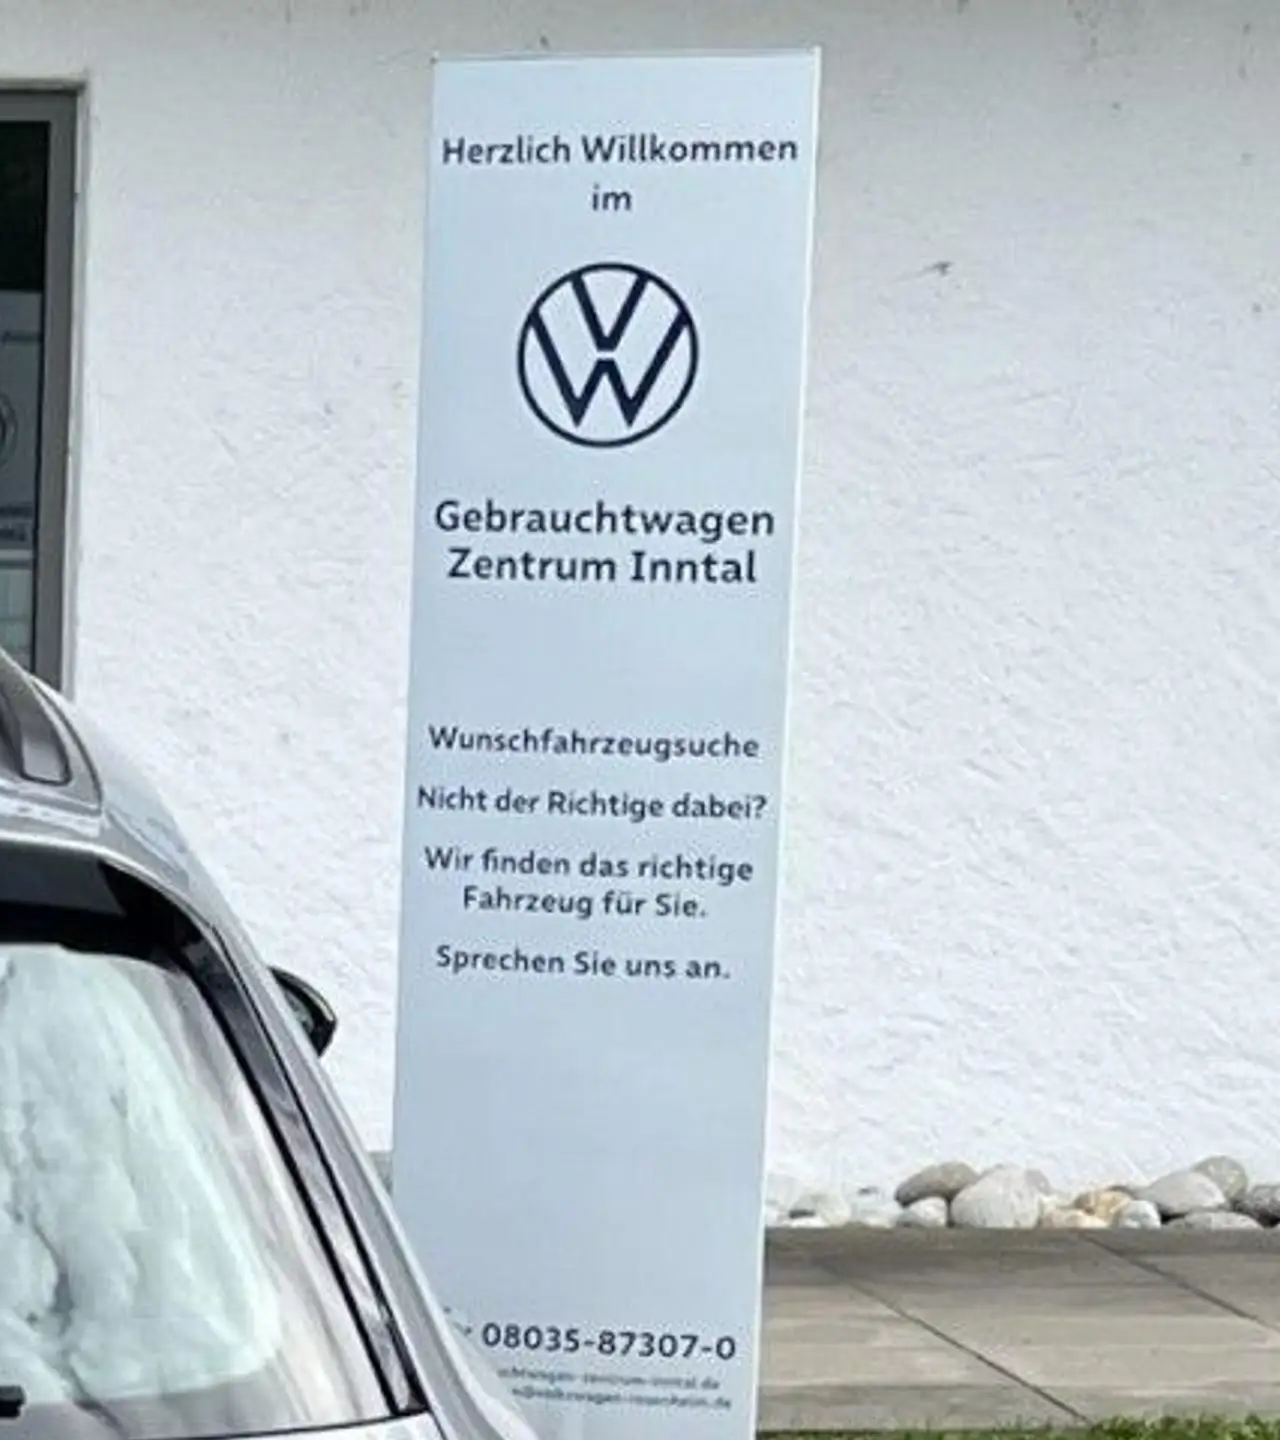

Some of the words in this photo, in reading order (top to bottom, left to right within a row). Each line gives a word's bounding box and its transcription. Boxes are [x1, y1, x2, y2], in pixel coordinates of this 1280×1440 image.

[441, 135, 570, 164] Herzlich
[581, 134, 798, 163] Willkommen
[592, 184, 632, 211] im
[435, 500, 775, 543] Gebrauchtwagen
[447, 547, 616, 583] Zentrum
[632, 549, 757, 584] Inntal
[428, 724, 760, 762] Wunschfahrzeugsuche
[417, 785, 488, 812] Nicht
[494, 787, 540, 813] der
[547, 789, 664, 823] Richtige
[671, 793, 768, 819] dabei?
[424, 846, 474, 872] Wir
[481, 847, 570, 876] finden
[579, 852, 629, 879] das
[638, 855, 753, 886] richtige
[463, 885, 593, 920] Fahrzeug
[601, 890, 647, 916] für
[655, 893, 707, 918] Sie.
[436, 945, 565, 976] Sprechen
[574, 951, 617, 977] Sie
[625, 956, 676, 978] uns
[685, 958, 731, 980] an.
[482, 1322, 737, 1360] 08035-87307-0
